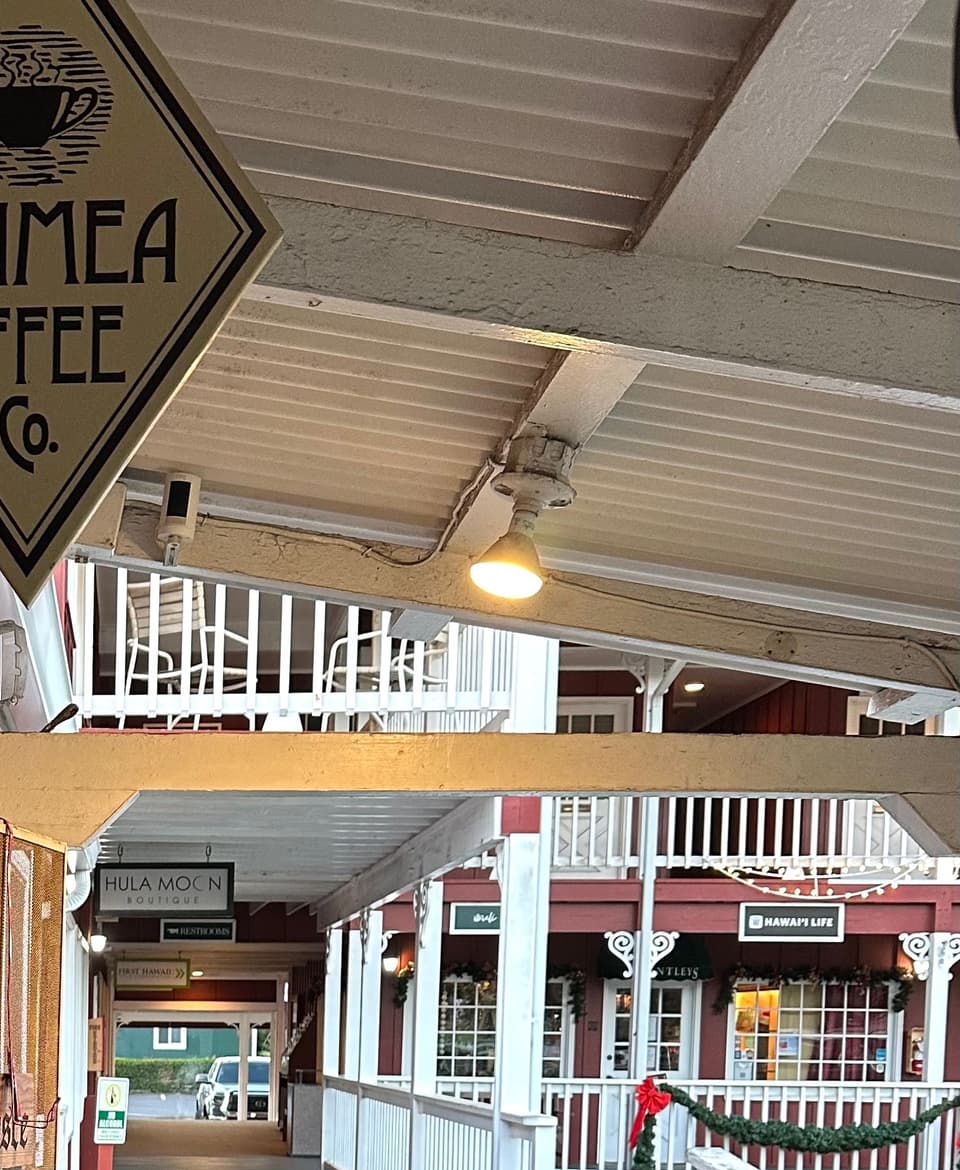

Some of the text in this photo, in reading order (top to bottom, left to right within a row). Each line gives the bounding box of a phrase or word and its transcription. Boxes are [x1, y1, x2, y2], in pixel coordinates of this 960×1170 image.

[105, 875, 221, 892] HULA MOON
[127, 895, 200, 905] BOUTIQUE
[810, 917, 834, 927] LIFE
[180, 927, 230, 936] RESTROOMS
[656, 966, 699, 979] NTLEYS
